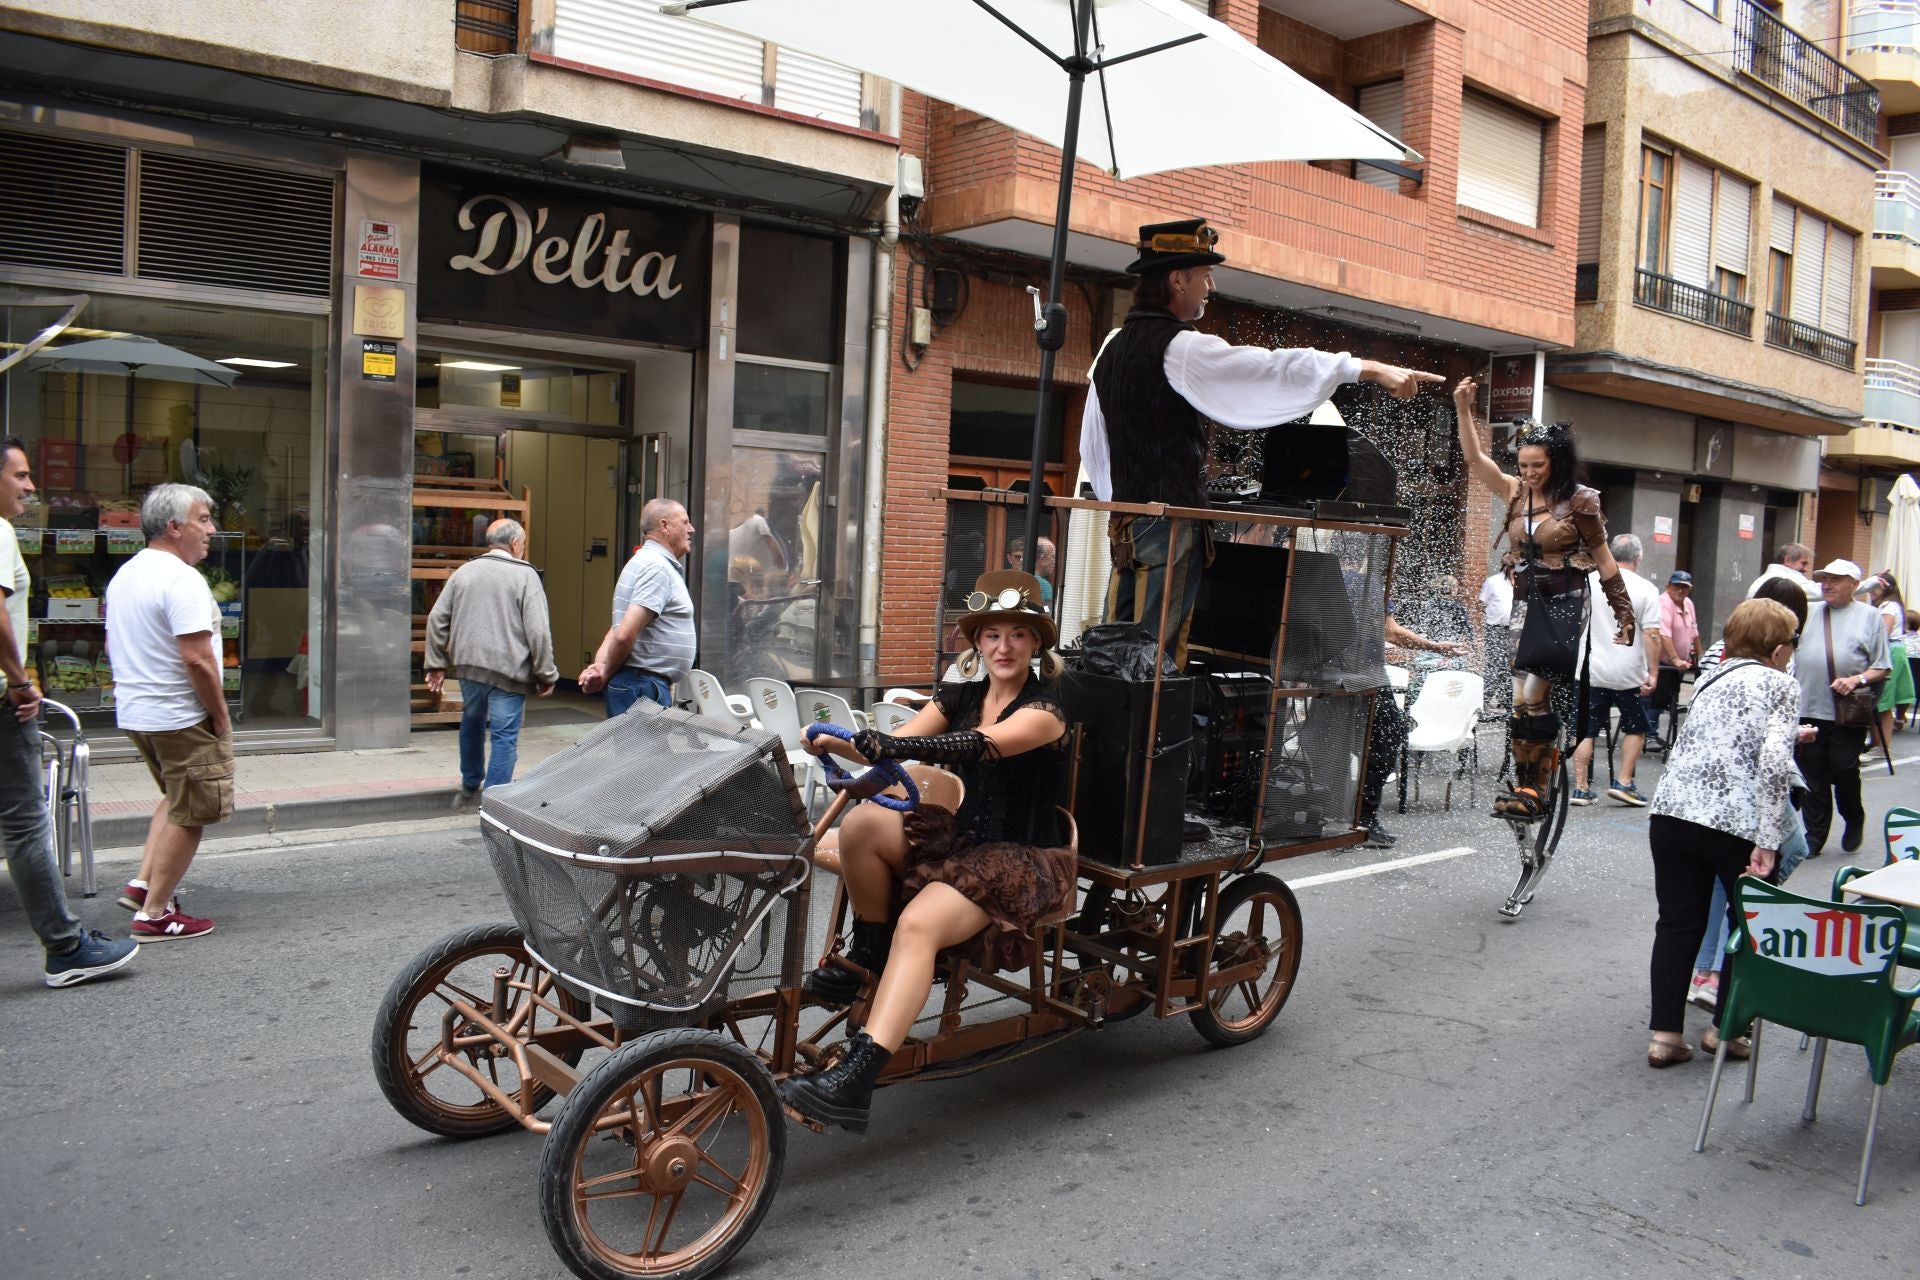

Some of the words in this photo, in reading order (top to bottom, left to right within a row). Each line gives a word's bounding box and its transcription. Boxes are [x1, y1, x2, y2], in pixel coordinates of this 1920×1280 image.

[360, 243, 399, 255] ALARMA
[449, 194, 682, 299] D'elta
[1492, 386, 1533, 398] OXFORD
